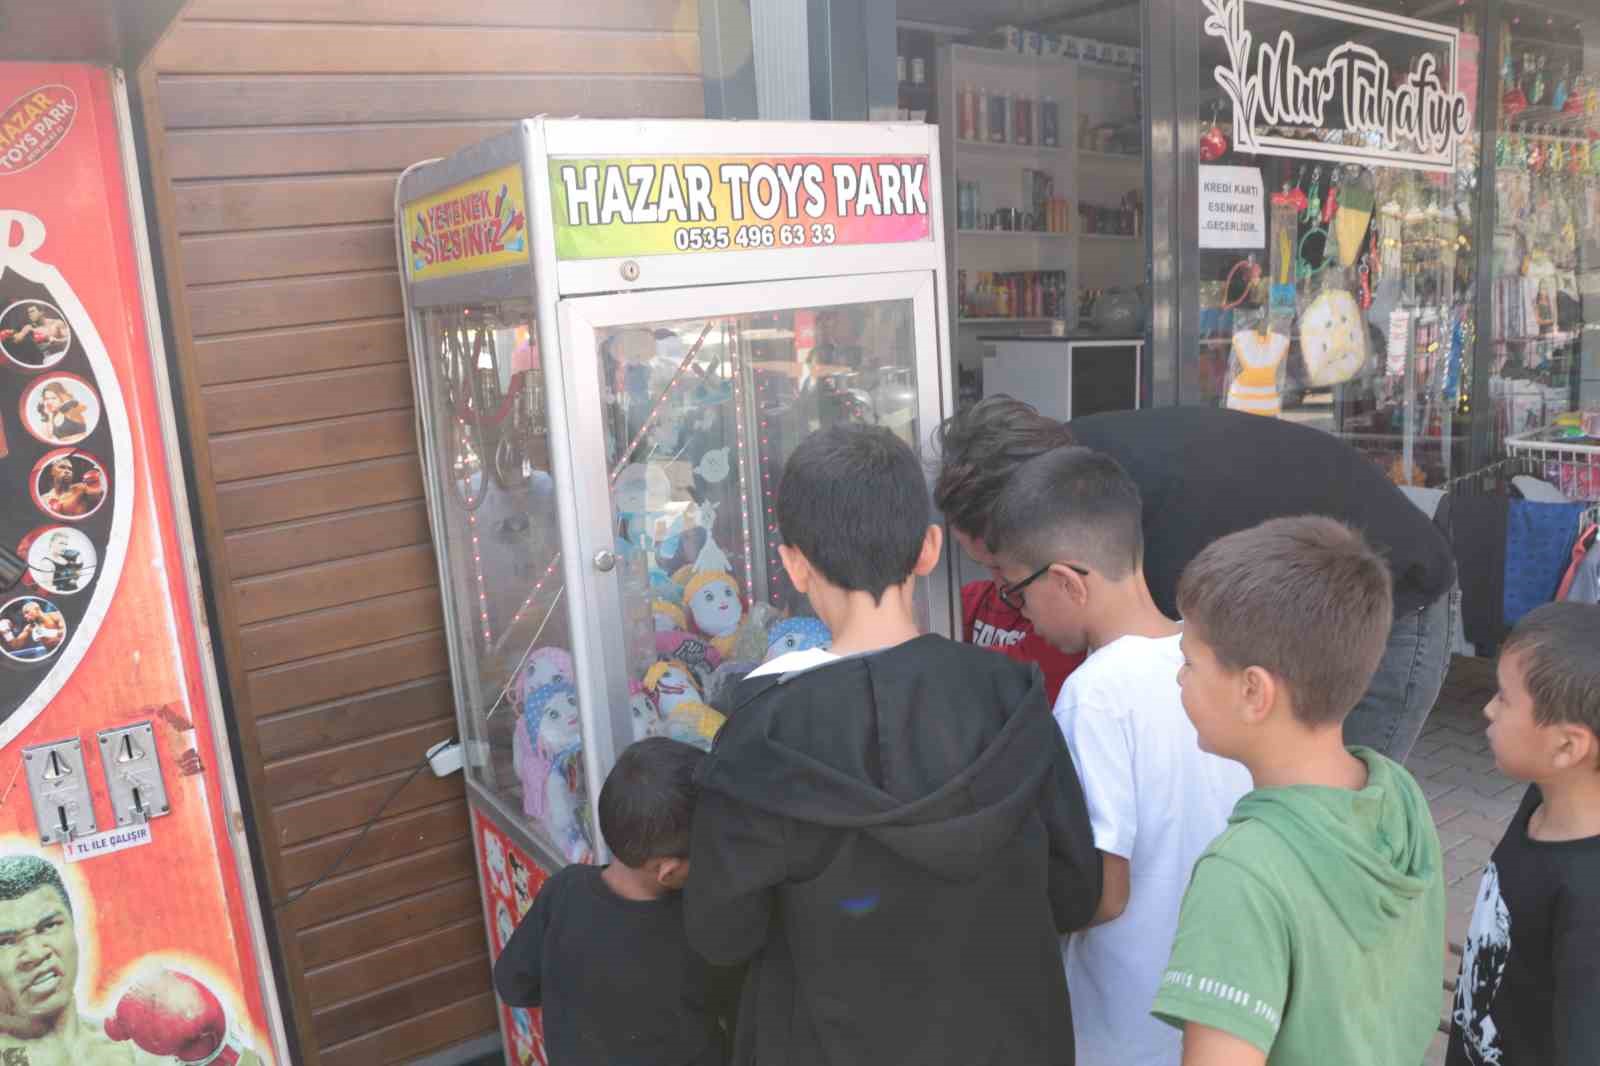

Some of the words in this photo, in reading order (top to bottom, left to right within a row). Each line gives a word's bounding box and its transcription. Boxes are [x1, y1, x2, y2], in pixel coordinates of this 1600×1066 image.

[1247, 30, 1335, 127] Nur
[1326, 41, 1471, 154] Tuhafiye
[0, 134, 39, 169] TOYS
[33, 98, 74, 137] PARK
[561, 164, 717, 226] HAZAR
[719, 162, 827, 220] TOYS
[831, 162, 928, 217] PARK
[674, 227, 731, 250] 0535
[734, 225, 775, 248] 496
[780, 224, 805, 246] 63
[810, 222, 837, 245] 33
[77, 843, 90, 854] TL
